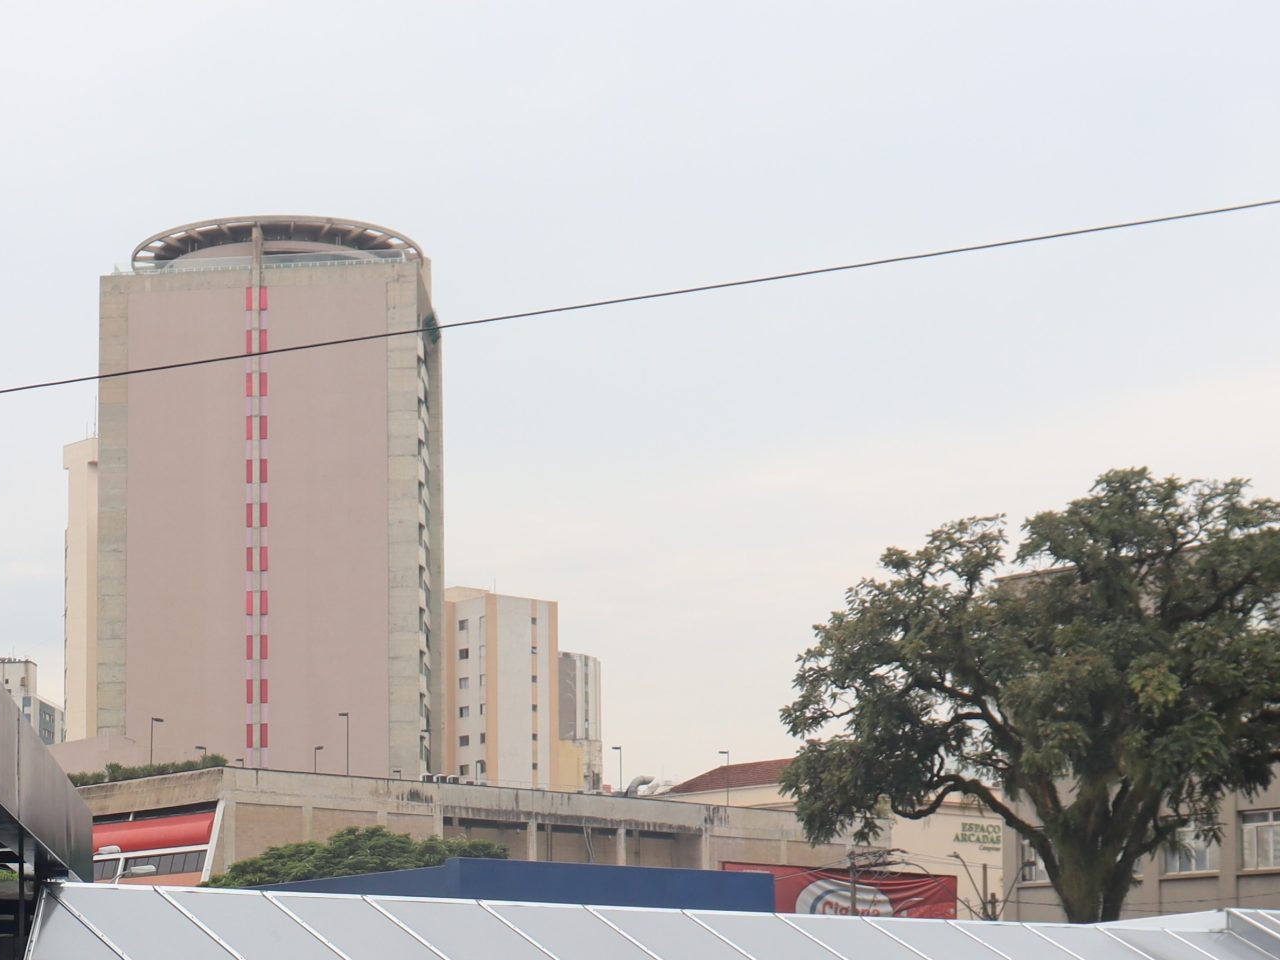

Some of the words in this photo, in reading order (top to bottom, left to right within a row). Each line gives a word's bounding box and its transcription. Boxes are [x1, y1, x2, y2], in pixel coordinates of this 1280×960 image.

[960, 822, 1001, 835] ESPAÇO
[953, 832, 1001, 844] ARCADAS
[822, 900, 880, 917] Cigna
